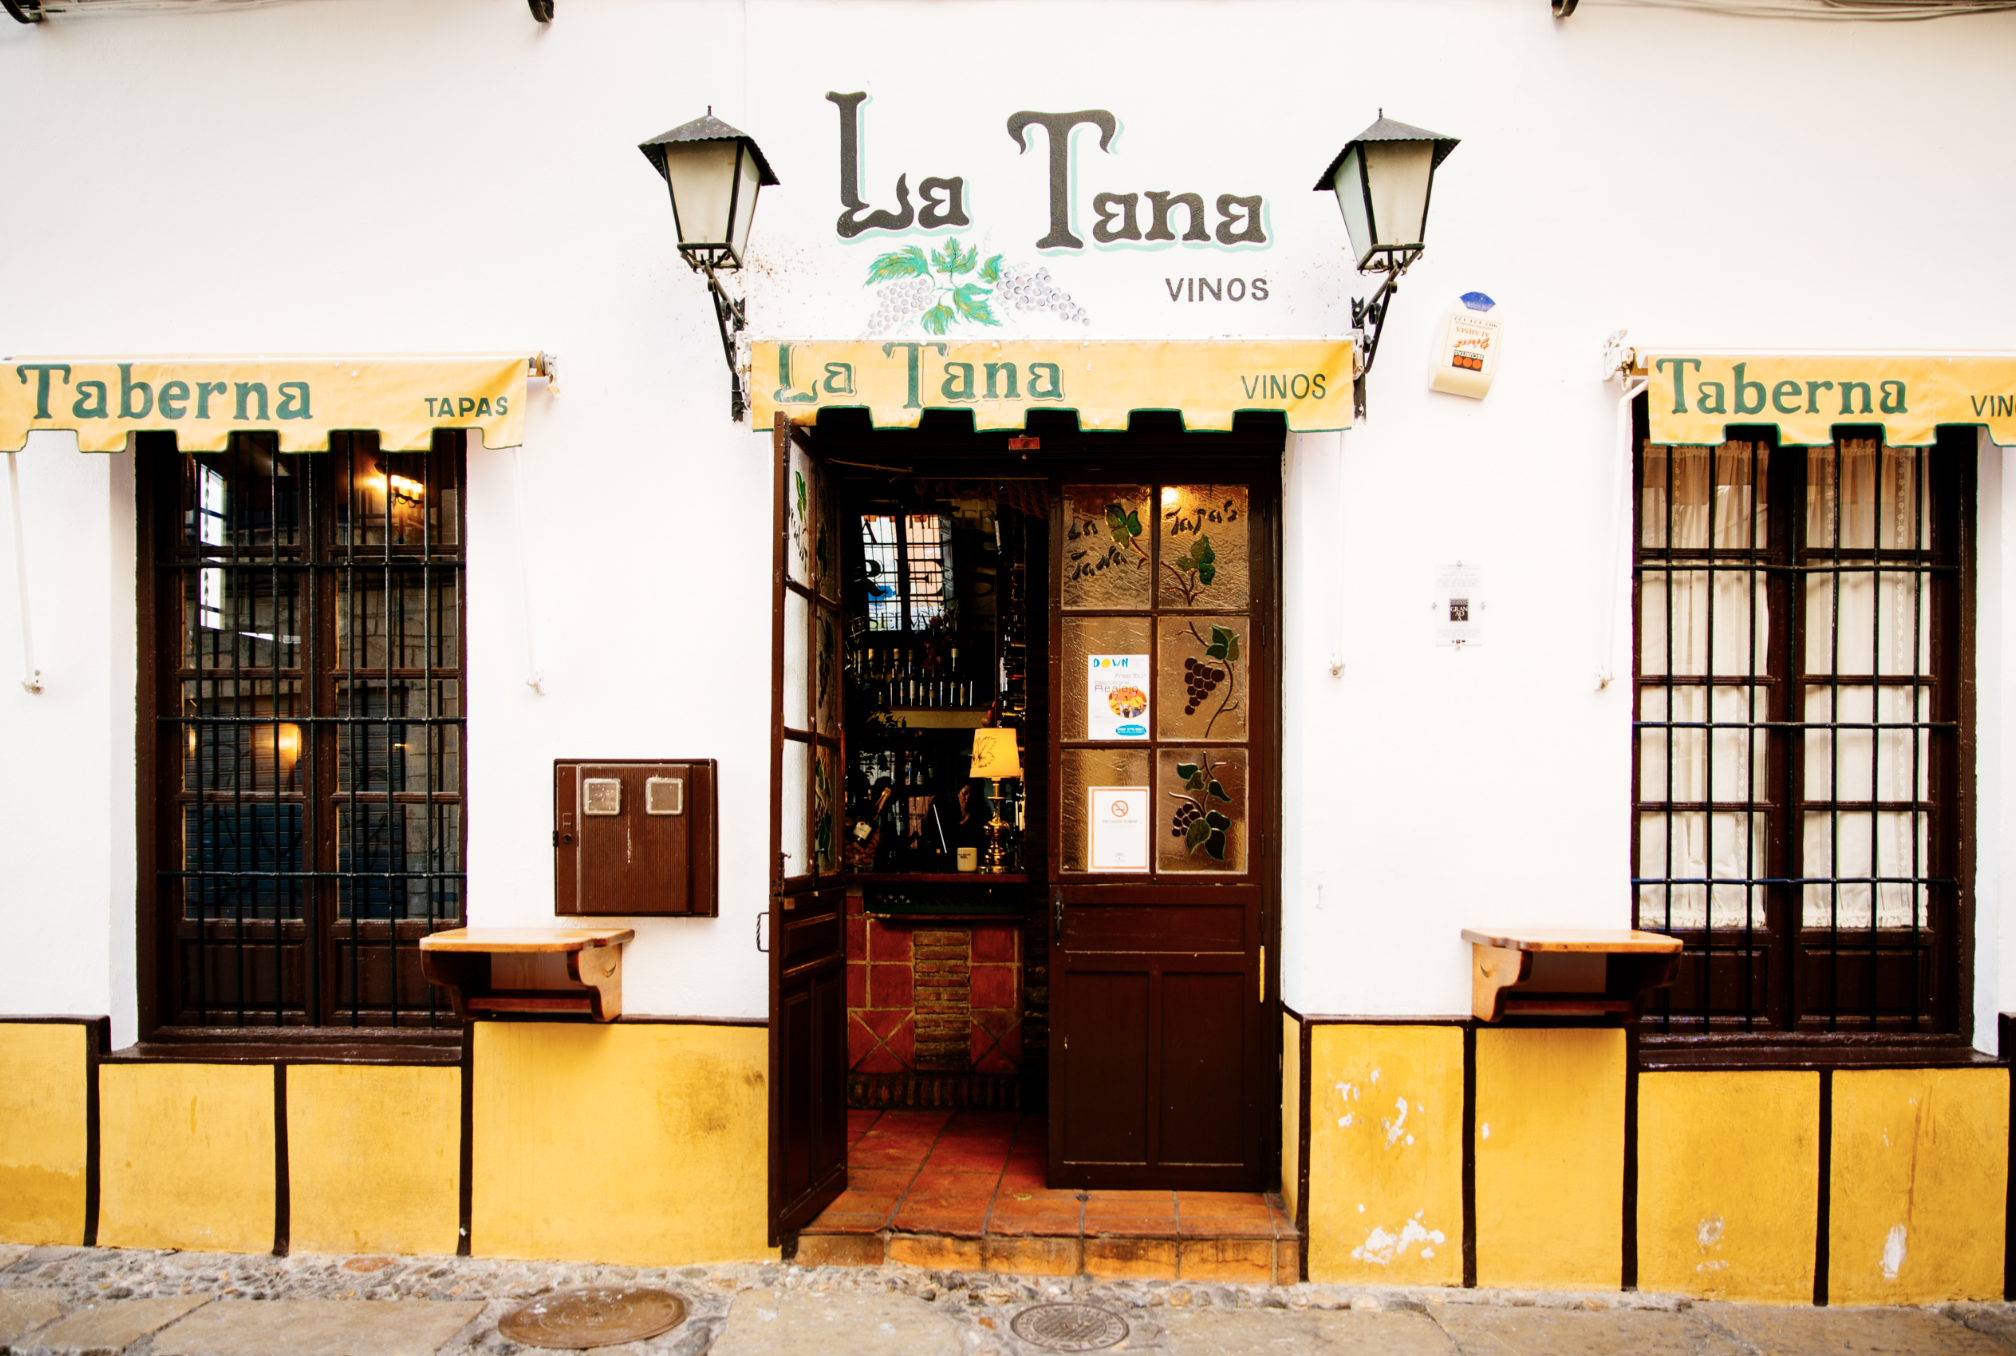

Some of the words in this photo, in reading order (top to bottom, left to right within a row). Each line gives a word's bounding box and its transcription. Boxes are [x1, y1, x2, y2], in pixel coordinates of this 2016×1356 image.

[825, 90, 972, 244] La
[1006, 108, 1272, 255] Tana
[1164, 277, 1270, 303] VINOS
[1452, 337, 1490, 350] Direct
[1456, 326, 1490, 337] ALARMA
[773, 341, 858, 405] La
[882, 341, 1066, 410] Tana
[1241, 373, 1327, 401] VINOS
[1655, 357, 1909, 416] Taberna
[16, 362, 313, 421] Taberna
[424, 395, 509, 419] TAPAS
[1970, 394, 2016, 418] VIN
[1067, 517, 1099, 540] La
[1070, 545, 1128, 581] Tana
[1093, 658, 1128, 668] DOWN
[1094, 685, 1139, 694] Realejo
